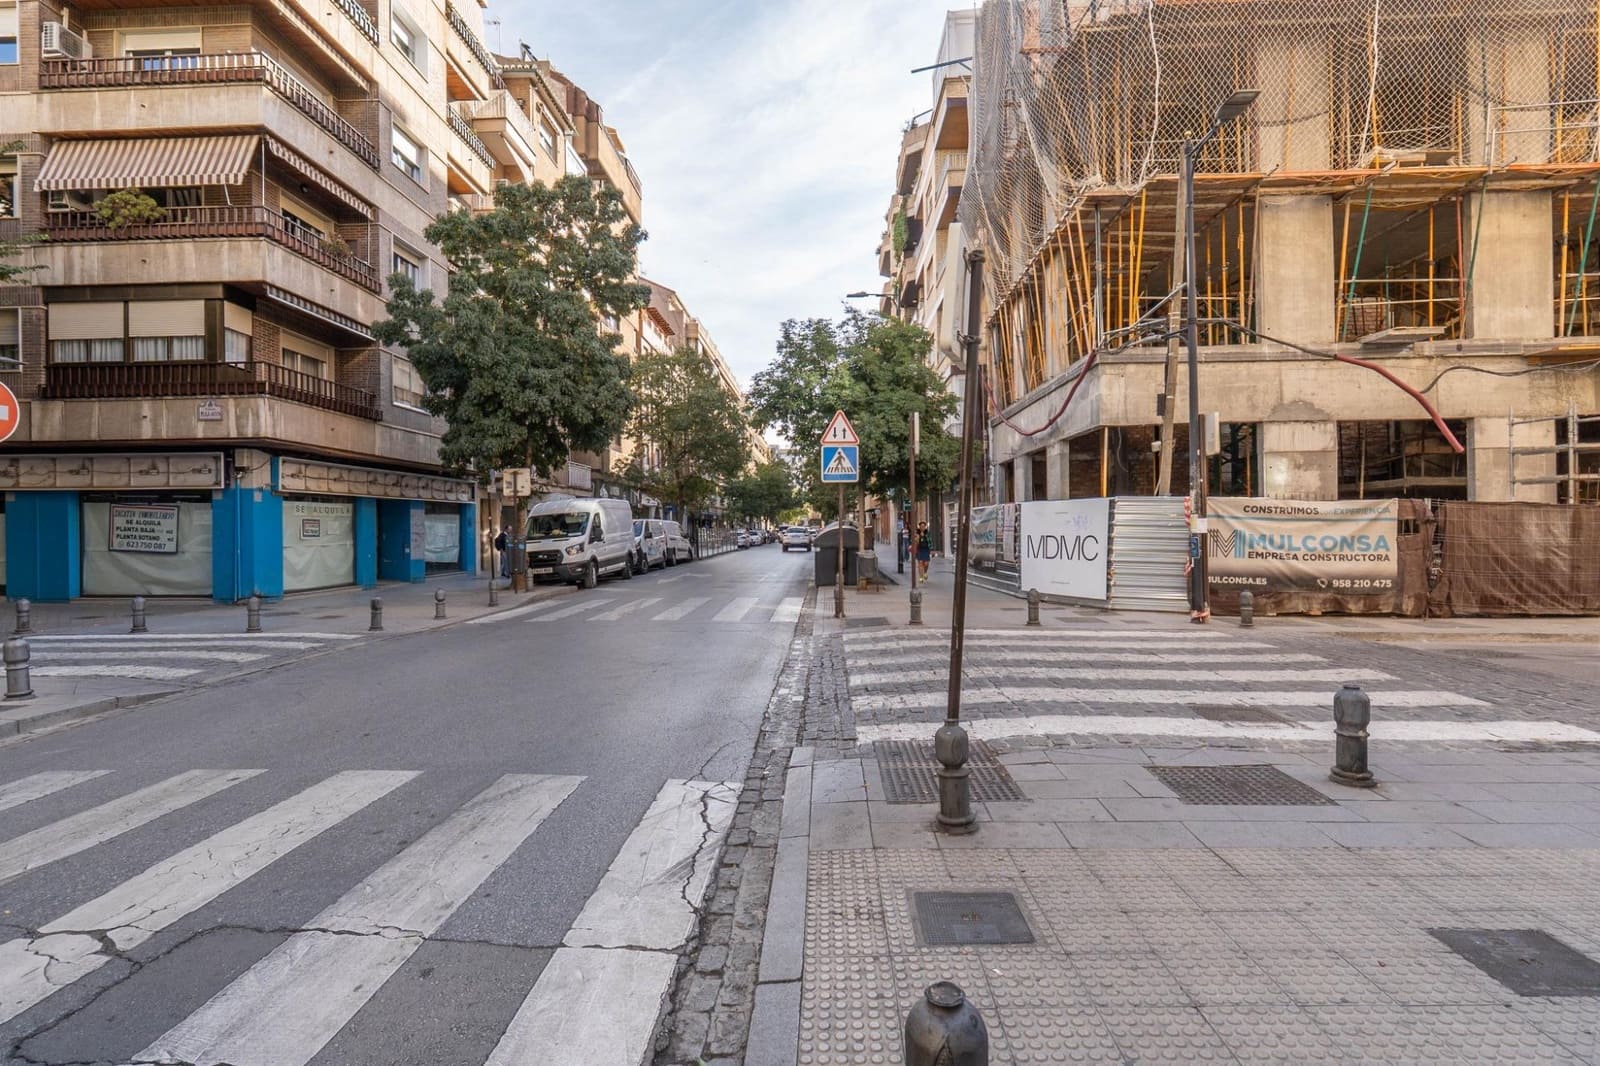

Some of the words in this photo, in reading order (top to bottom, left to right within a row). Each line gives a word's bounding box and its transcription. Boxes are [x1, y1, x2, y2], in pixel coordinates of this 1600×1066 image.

[295, 504, 305, 513] SE
[313, 505, 351, 514] ALQUILA
[1243, 505, 1320, 515] CONSTRUIMOS
[1247, 533, 1390, 552] MULCONSA
[1027, 535, 1099, 561] MDMC
[1247, 551, 1299, 561] EMPRESA
[1302, 553, 1391, 562] CONSTRUCTORA
[1332, 580, 1352, 588] 958
[1353, 580, 1371, 588] 210
[1372, 579, 1392, 588] 475
